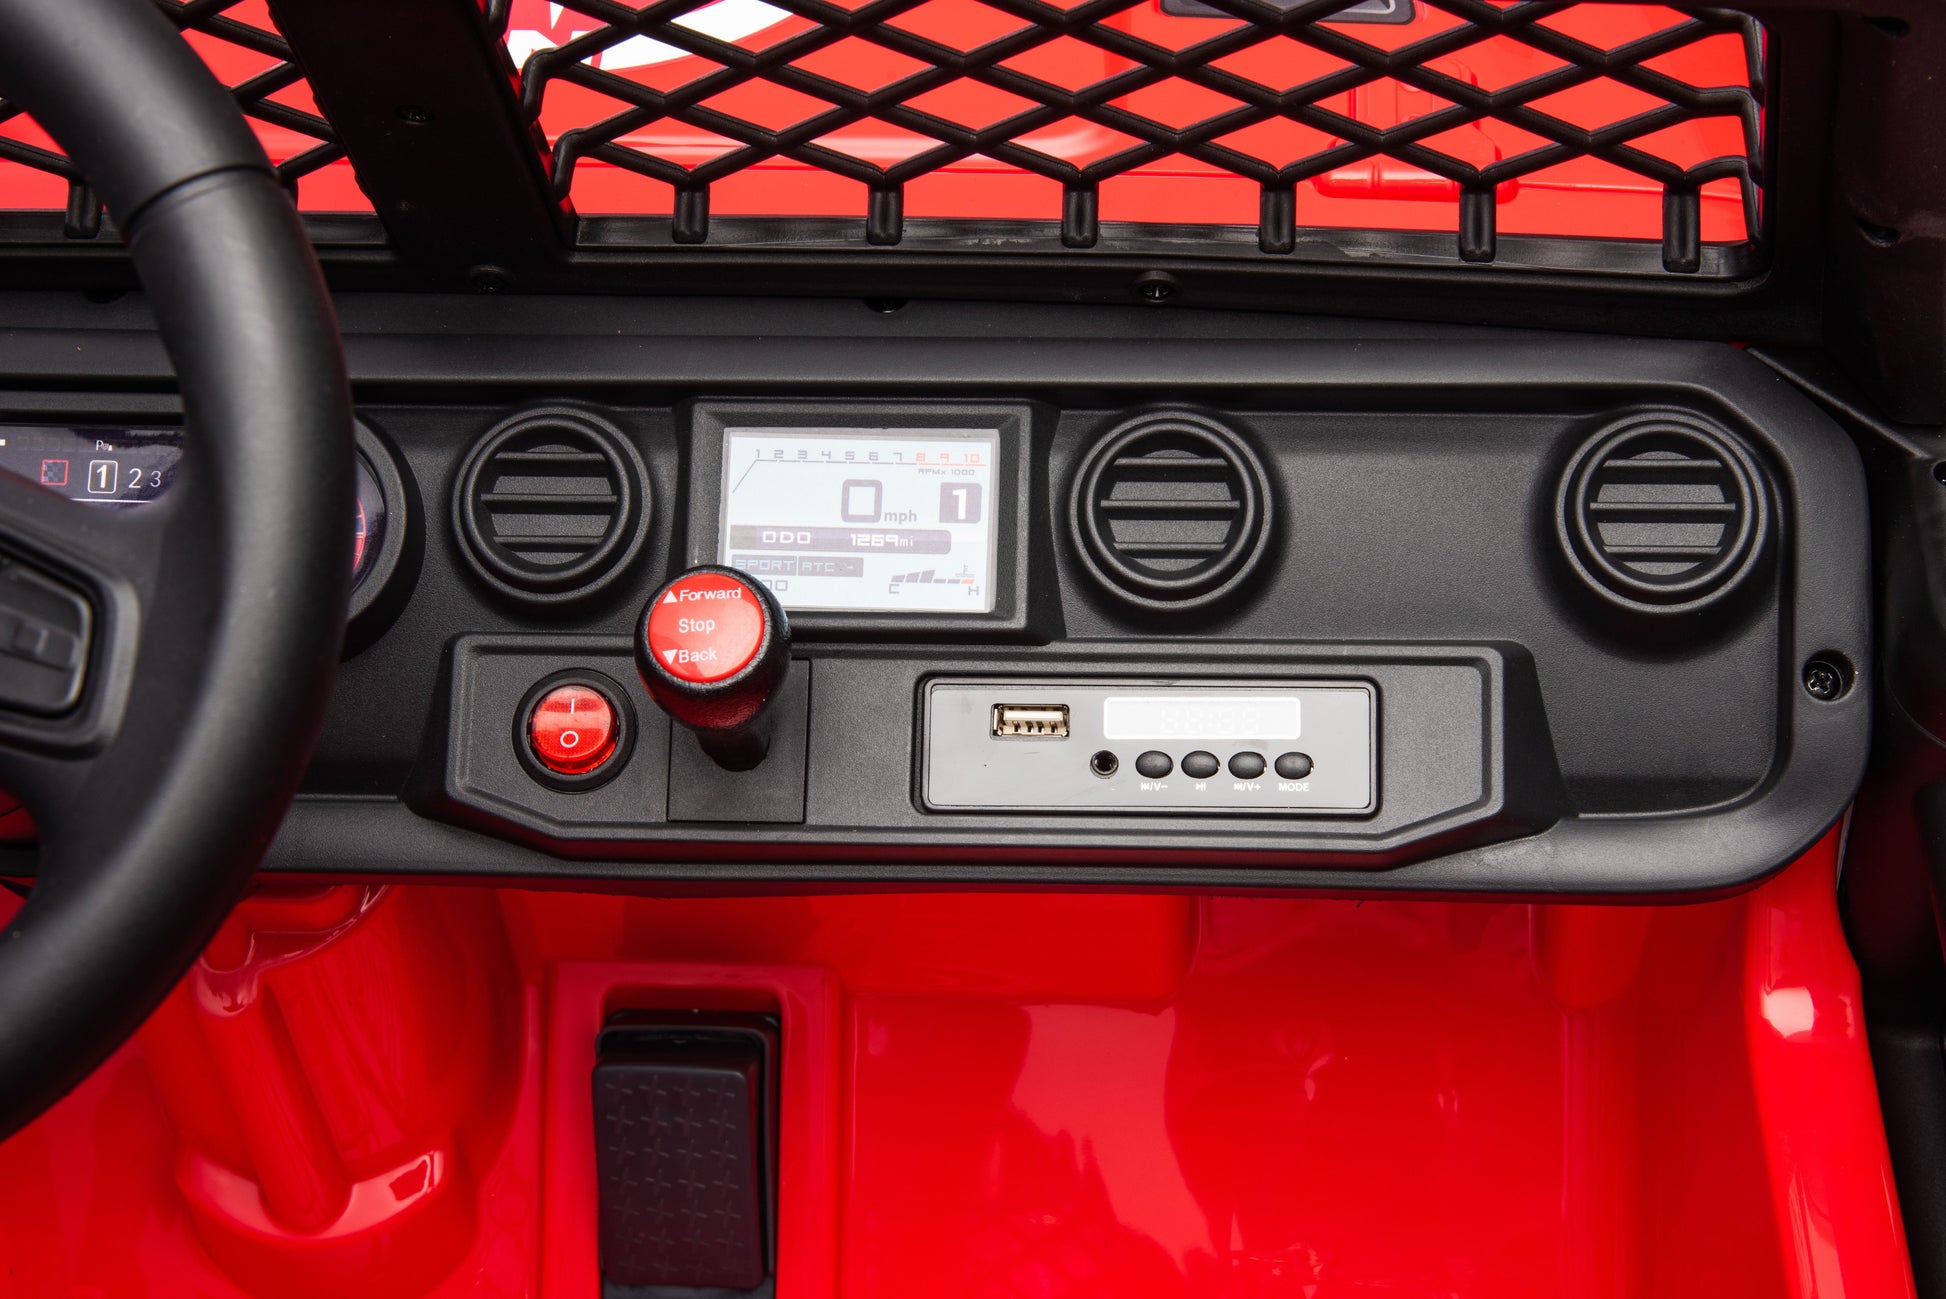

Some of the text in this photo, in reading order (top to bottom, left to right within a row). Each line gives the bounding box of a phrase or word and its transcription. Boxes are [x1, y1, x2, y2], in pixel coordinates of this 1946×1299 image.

[756, 449, 980, 463] 1 2 3 4 5 6 7 8 9 10
[97, 465, 161, 489] 1 2 3
[952, 488, 967, 519] 1
[884, 510, 917, 524] mph
[762, 531, 811, 544] ODO
[735, 559, 794, 571] SPORT
[802, 562, 834, 571] ATC
[680, 587, 741, 602] Forward
[889, 584, 899, 593] C
[968, 585, 979, 596] H
[678, 618, 715, 635] Stop
[679, 649, 717, 663] Back
[1279, 783, 1309, 791] MODE
